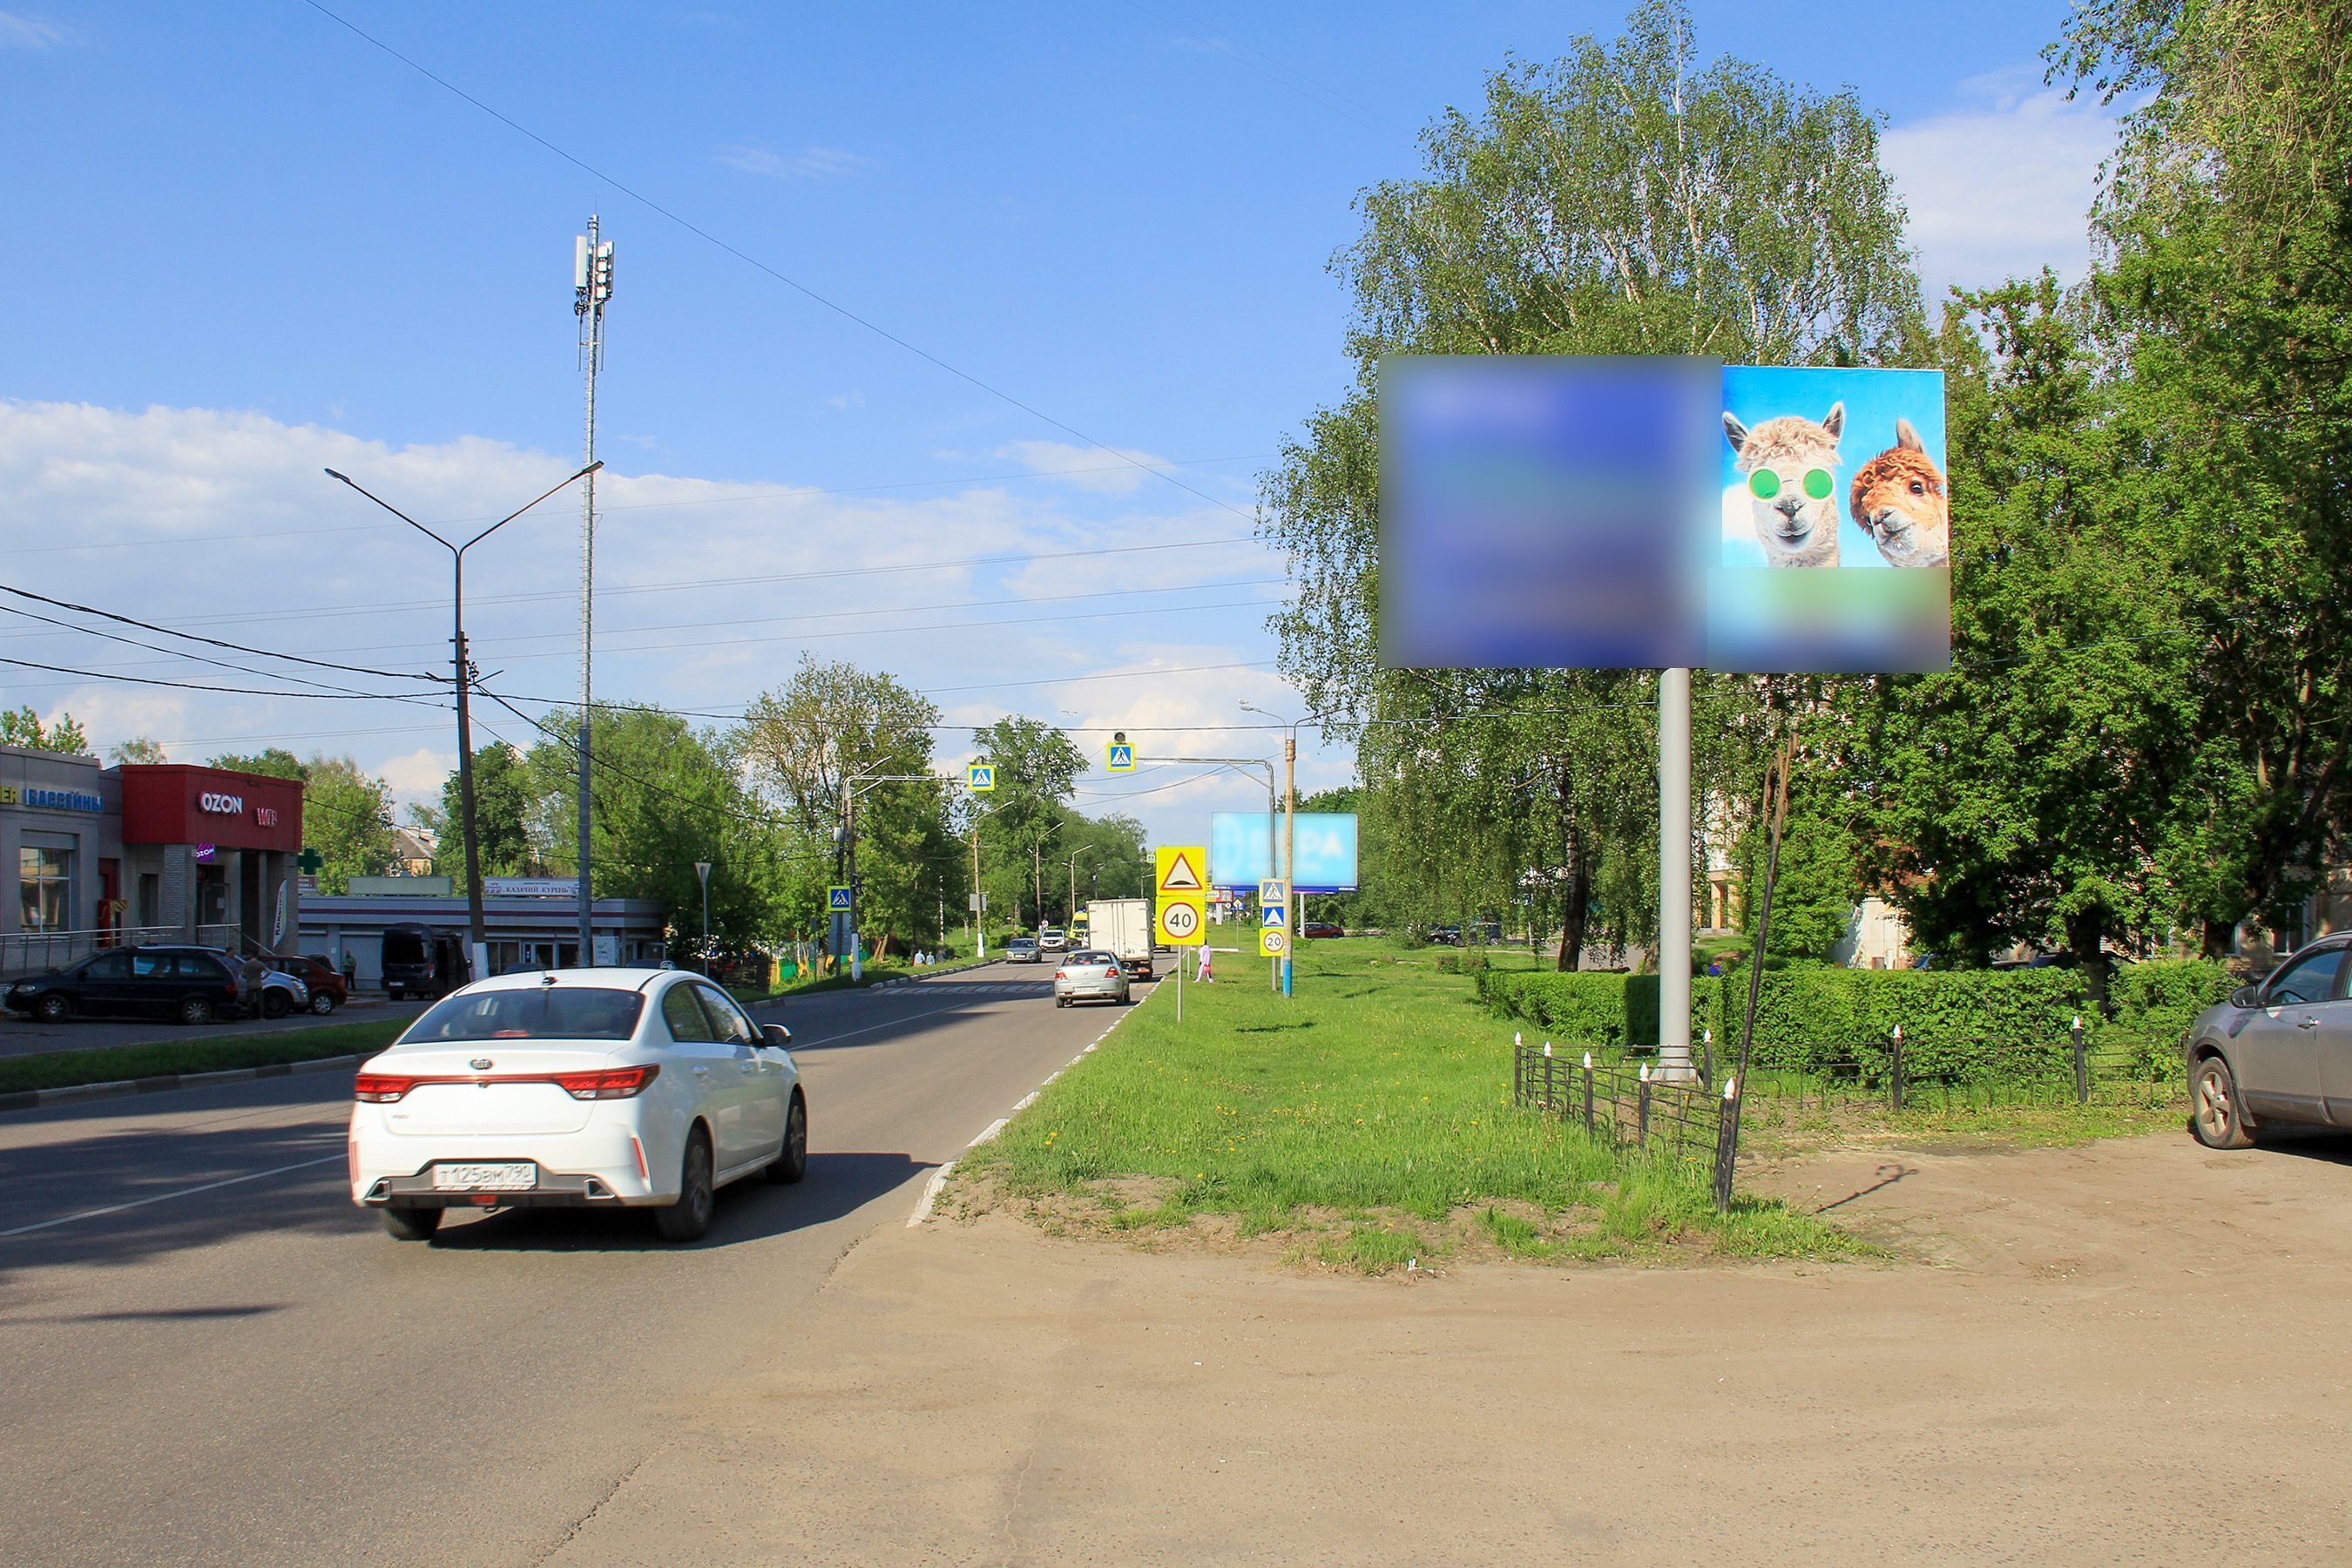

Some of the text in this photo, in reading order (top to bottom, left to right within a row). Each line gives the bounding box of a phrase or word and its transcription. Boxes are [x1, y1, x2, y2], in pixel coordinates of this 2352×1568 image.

[25, 787, 104, 813] БАССЕЙНЫ
[200, 793, 244, 814] OZON
[1169, 913, 1192, 928] 40
[1267, 937, 1281, 947] 20
